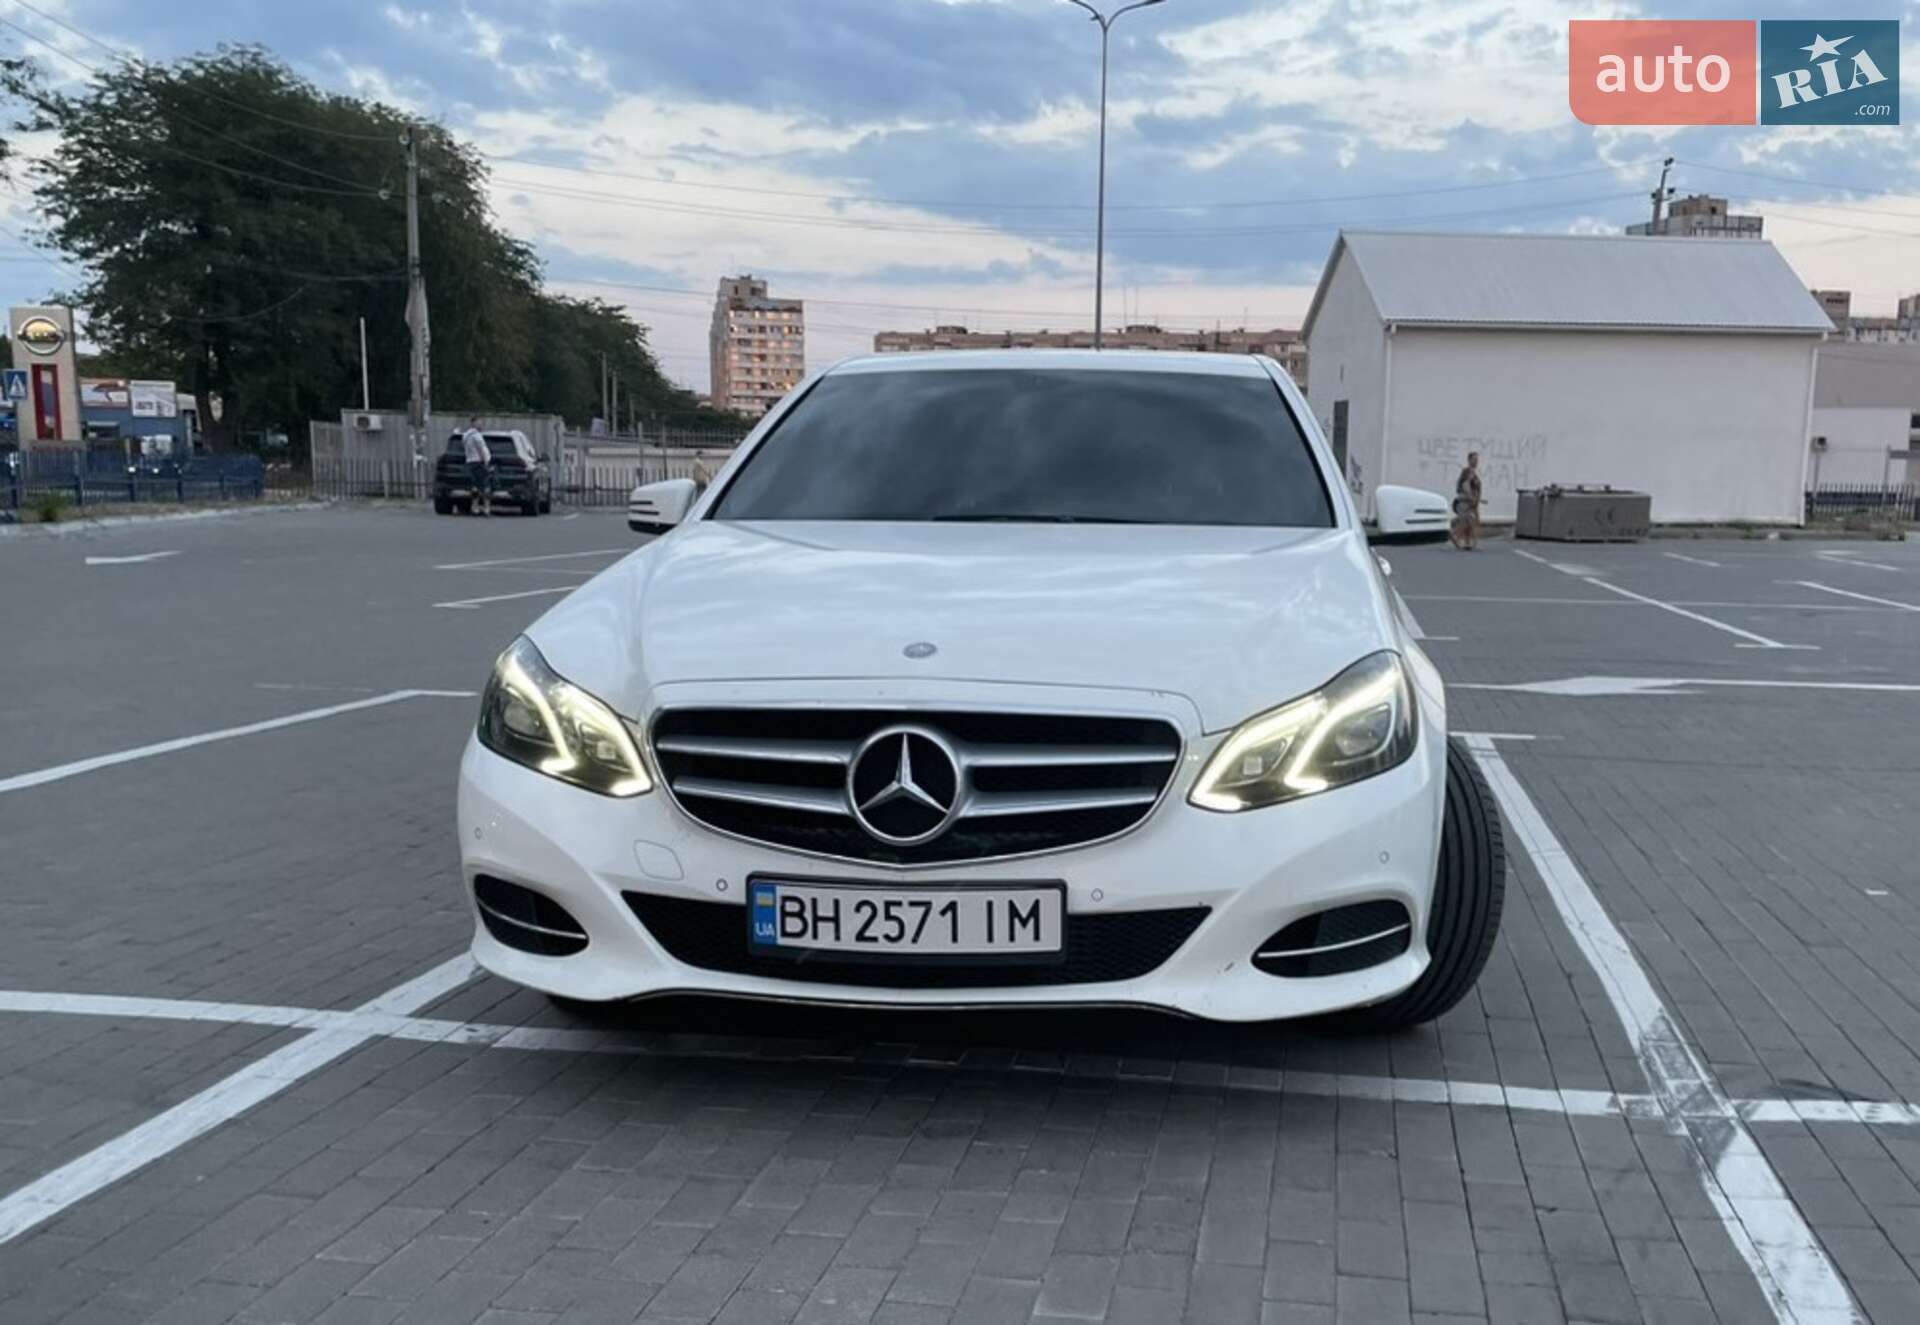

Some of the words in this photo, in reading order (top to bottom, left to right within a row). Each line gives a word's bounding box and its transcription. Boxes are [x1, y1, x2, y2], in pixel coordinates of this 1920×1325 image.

[755, 923, 775, 937] UA
[779, 895, 841, 943] BH
[854, 899, 959, 944] 2571
[987, 898, 1041, 943] IM
